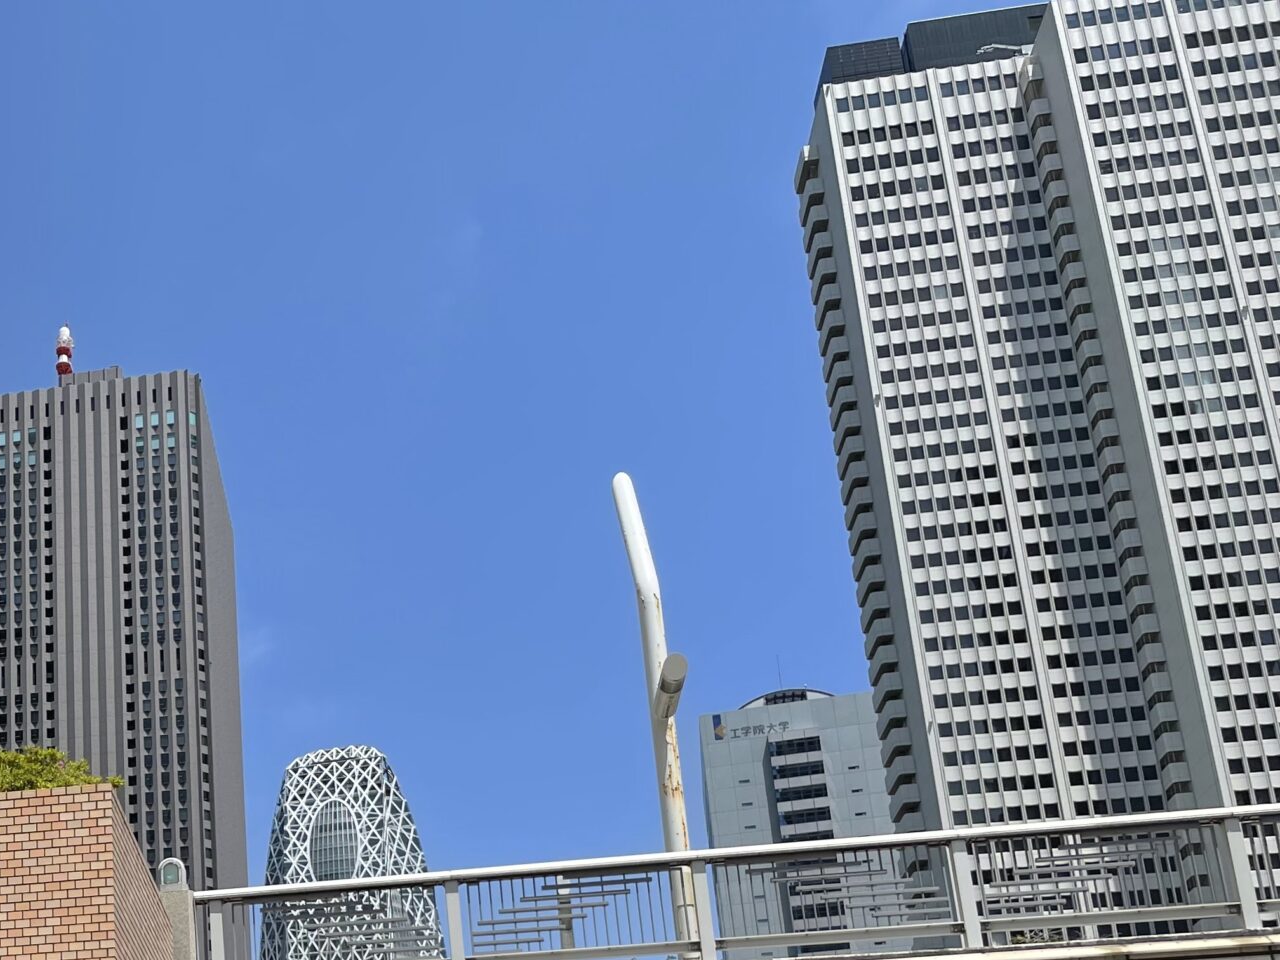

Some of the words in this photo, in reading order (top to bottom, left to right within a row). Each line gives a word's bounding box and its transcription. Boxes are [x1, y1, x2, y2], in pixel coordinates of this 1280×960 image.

[730, 721, 790, 739] 工学院大学
